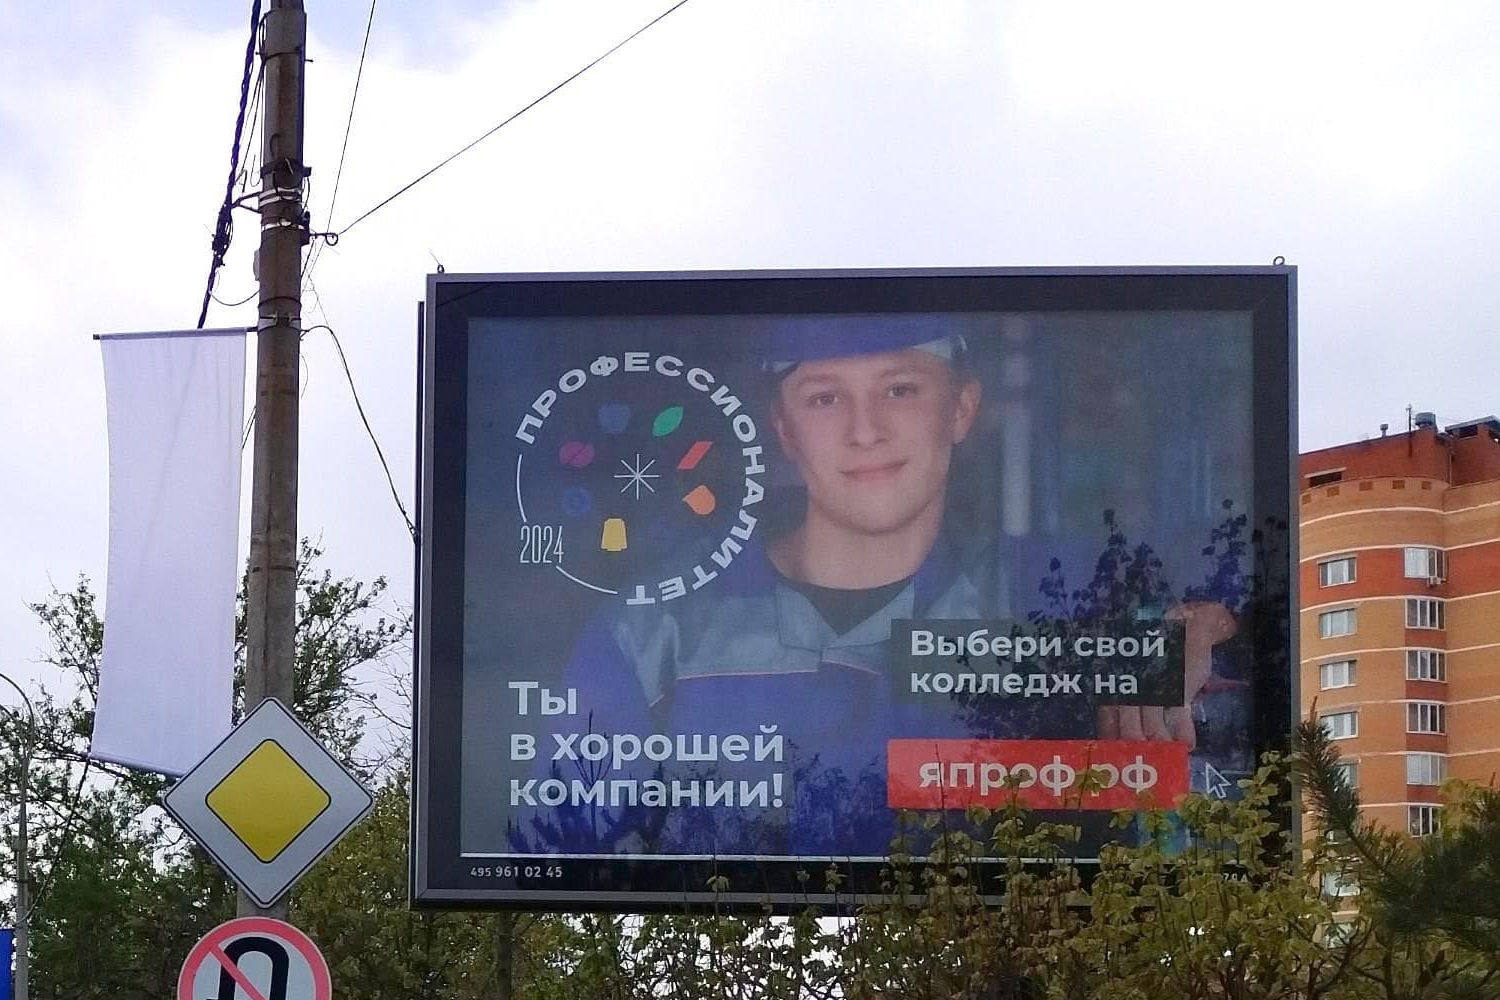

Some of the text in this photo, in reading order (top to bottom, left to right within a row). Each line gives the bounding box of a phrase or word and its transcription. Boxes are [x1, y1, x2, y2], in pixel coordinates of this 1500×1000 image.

[516, 352, 765, 605] ПРОФЕССИОНАЛИТЕТ
[520, 525, 564, 564] 2024
[911, 629, 1165, 662] Выбери свой
[508, 681, 577, 715] Ты
[911, 672, 1138, 698] колледж на
[510, 724, 784, 770] в хорошей
[510, 773, 783, 808] компании!
[470, 866, 563, 878] 495 961 02 45
